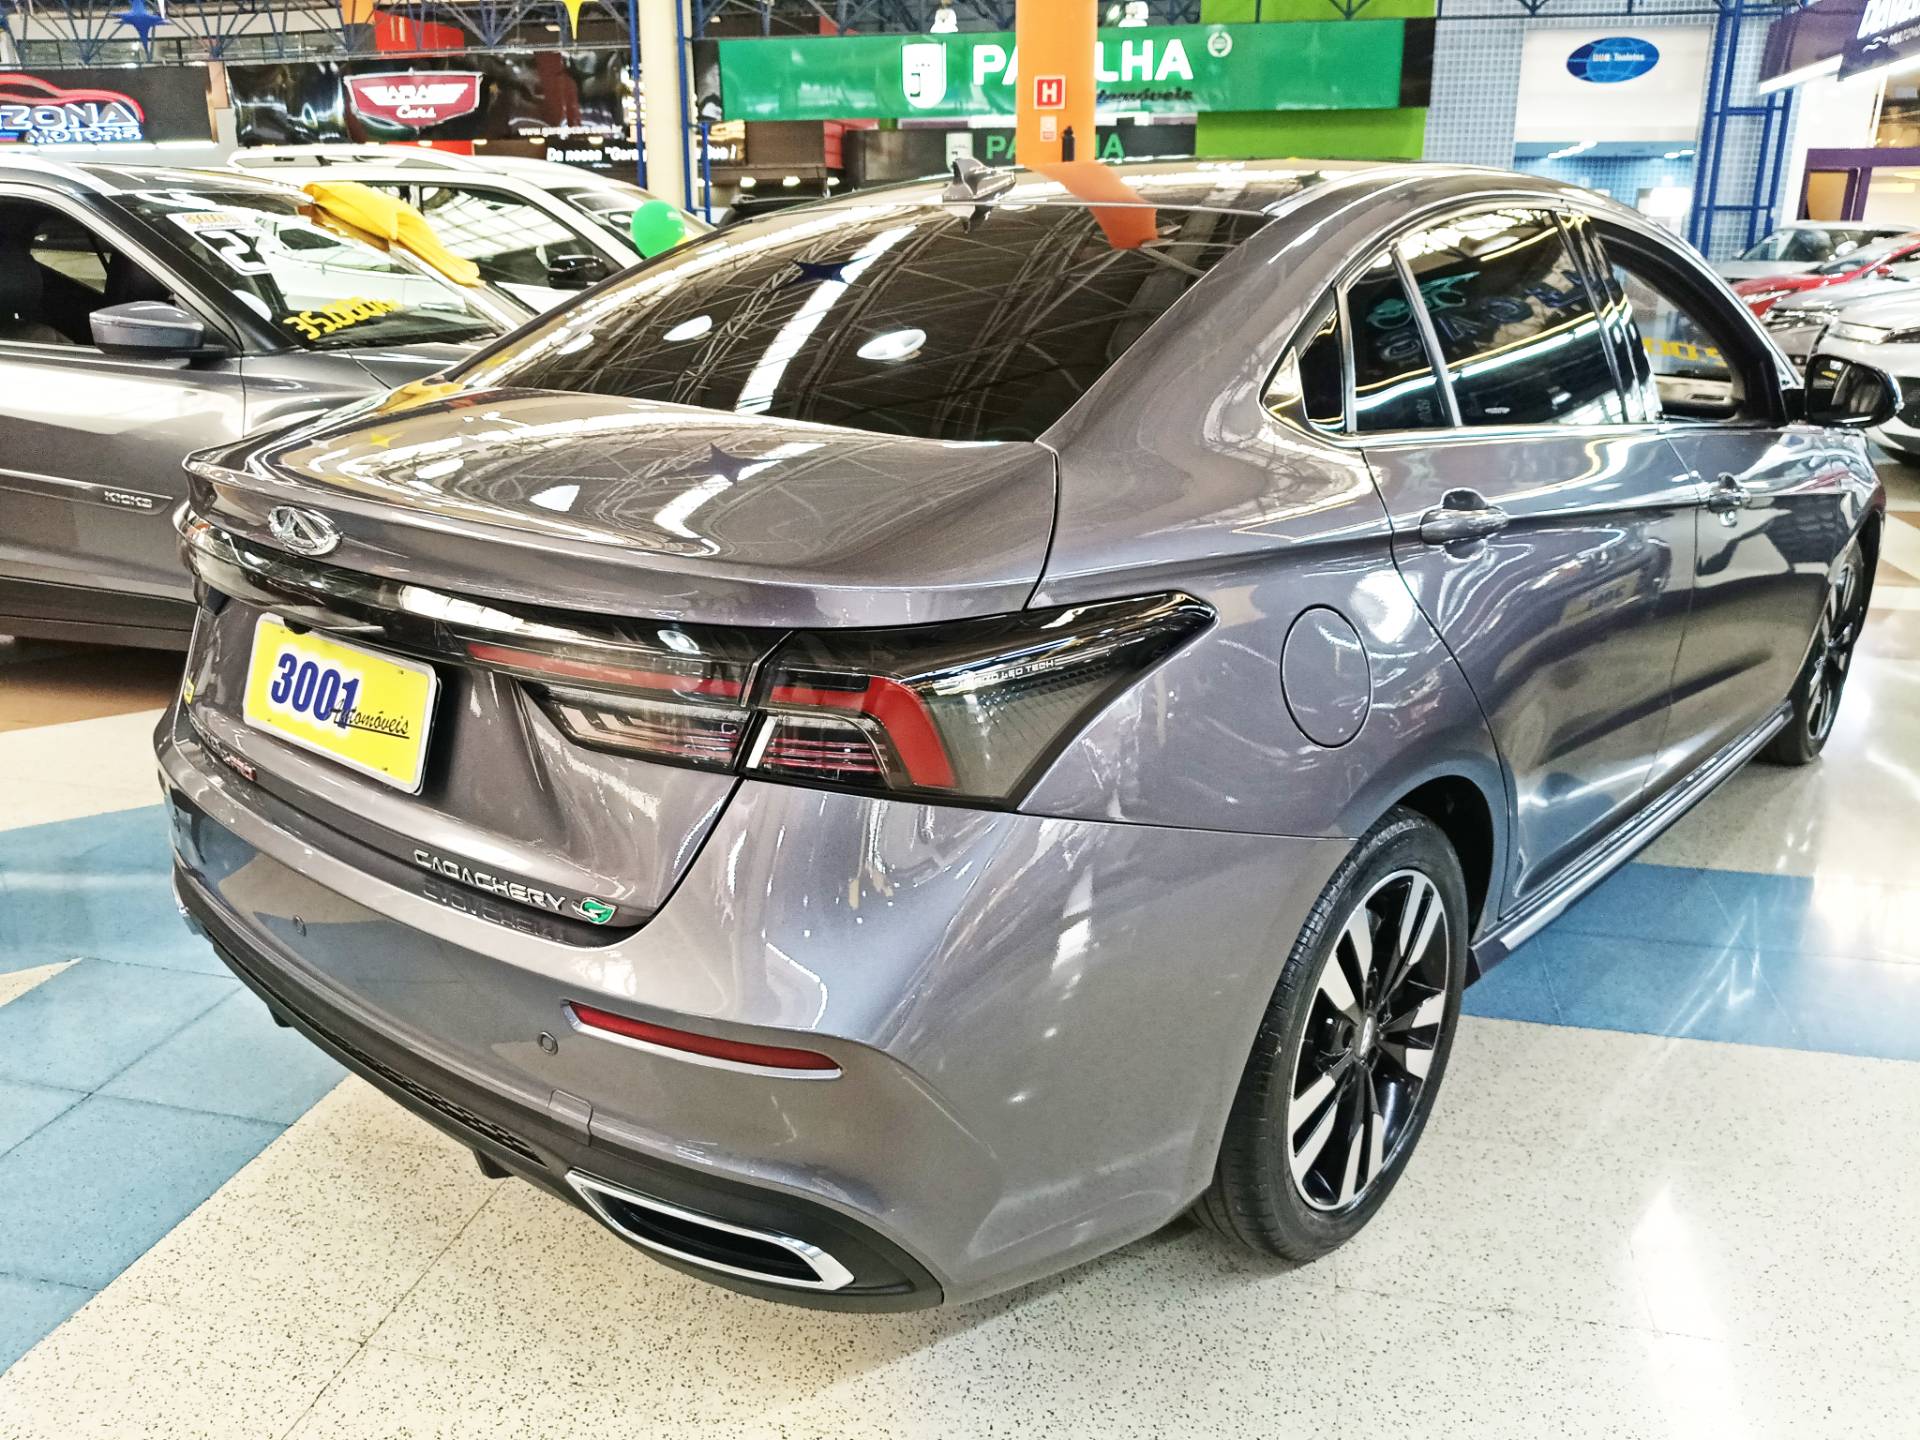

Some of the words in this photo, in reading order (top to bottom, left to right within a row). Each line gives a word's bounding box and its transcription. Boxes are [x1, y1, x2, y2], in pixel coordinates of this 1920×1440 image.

[1042, 82, 1057, 103] H
[25, 126, 143, 143] MOTORS
[104, 490, 153, 509] KICKS
[1026, 660, 1054, 673] TECH
[271, 653, 360, 729] 3001
[328, 697, 410, 739] Automóveis
